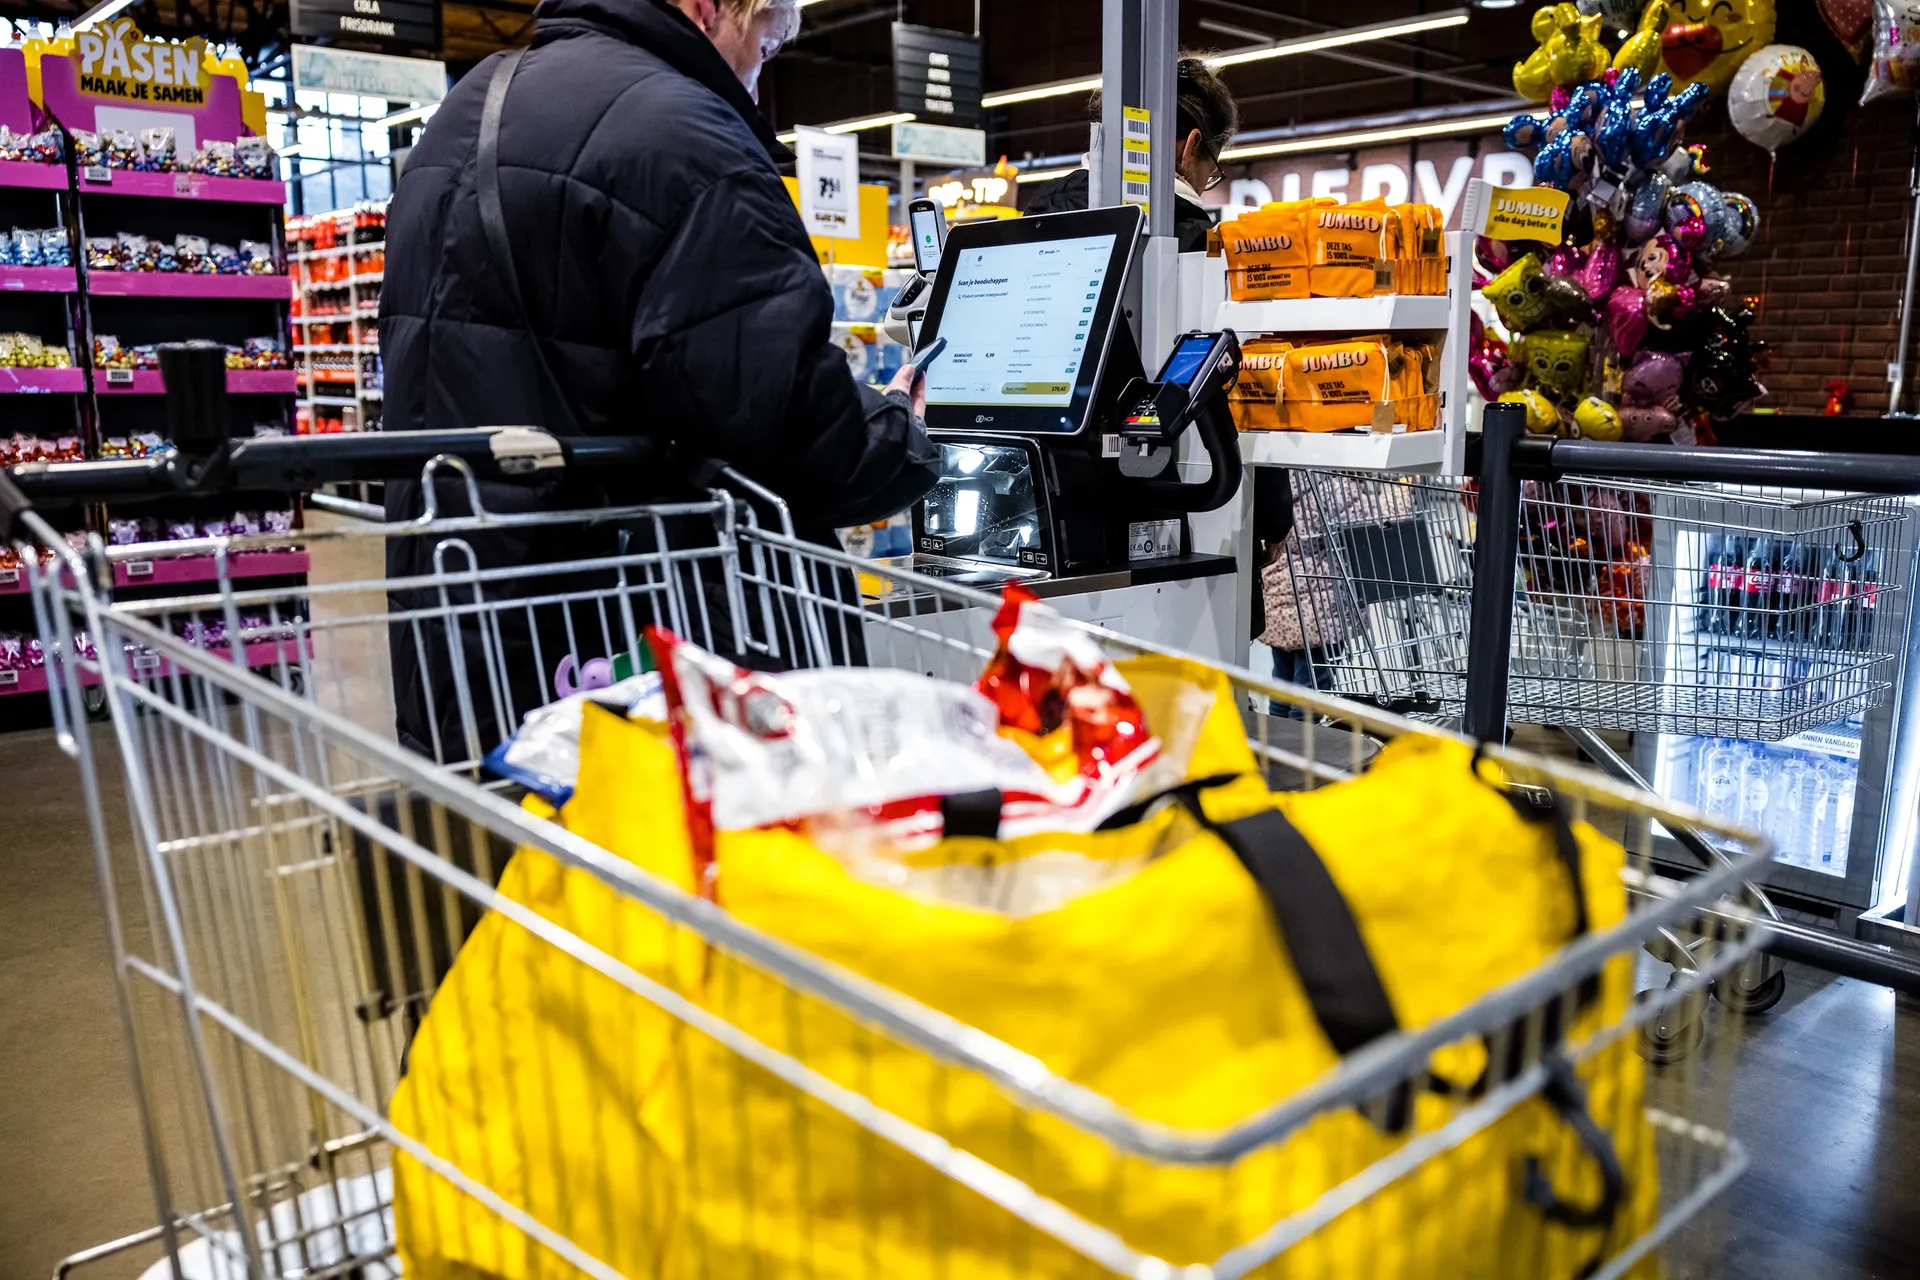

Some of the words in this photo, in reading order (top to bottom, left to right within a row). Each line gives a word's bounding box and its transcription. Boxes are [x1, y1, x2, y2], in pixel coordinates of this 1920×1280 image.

[353, 0, 380, 14] COLA
[81, 76, 127, 96] MAAK
[131, 83, 148, 99] JE
[153, 86, 203, 103] SAMEN
[1497, 199, 1559, 219] JUMBO
[1318, 212, 1380, 232] JUMBO
[1494, 214, 1510, 223] elke
[1511, 216, 1526, 228] dag
[1527, 219, 1548, 228] beter
[1234, 235, 1292, 254] JUMBO
[1326, 242, 1340, 251] DEZE
[1341, 242, 1352, 251] TAS
[1326, 252, 1332, 260] IS
[968, 279, 973, 287] je
[974, 277, 1008, 285] boodschappen
[1247, 273, 1252, 282] IS
[1239, 354, 1284, 370] MBO
[1302, 349, 1368, 373] JUMBO
[1318, 382, 1333, 390] DEZE
[1824, 737, 1859, 749] VANDAAG?
